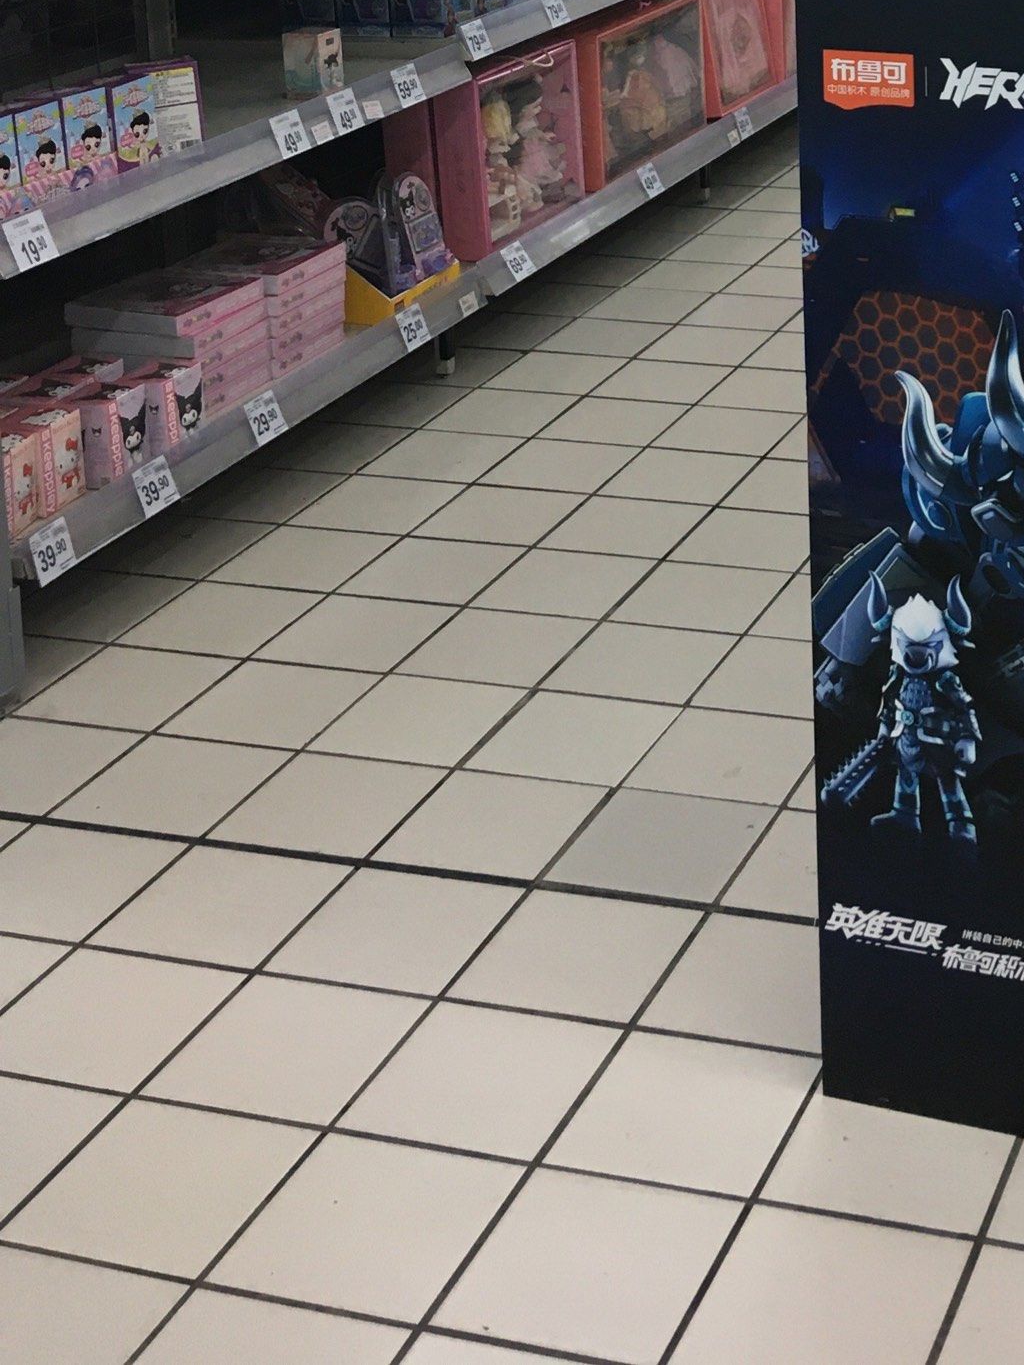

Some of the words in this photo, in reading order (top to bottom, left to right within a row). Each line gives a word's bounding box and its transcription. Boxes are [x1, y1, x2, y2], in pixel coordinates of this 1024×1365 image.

[830, 57, 907, 85] 布鲁可
[827, 83, 867, 97] 中国积木
[870, 86, 911, 99] 原创品牌
[253, 408, 278, 436] 29.90
[141, 473, 169, 507] 39.90
[37, 537, 68, 573] 39.90
[824, 902, 948, 951] 英雄无限
